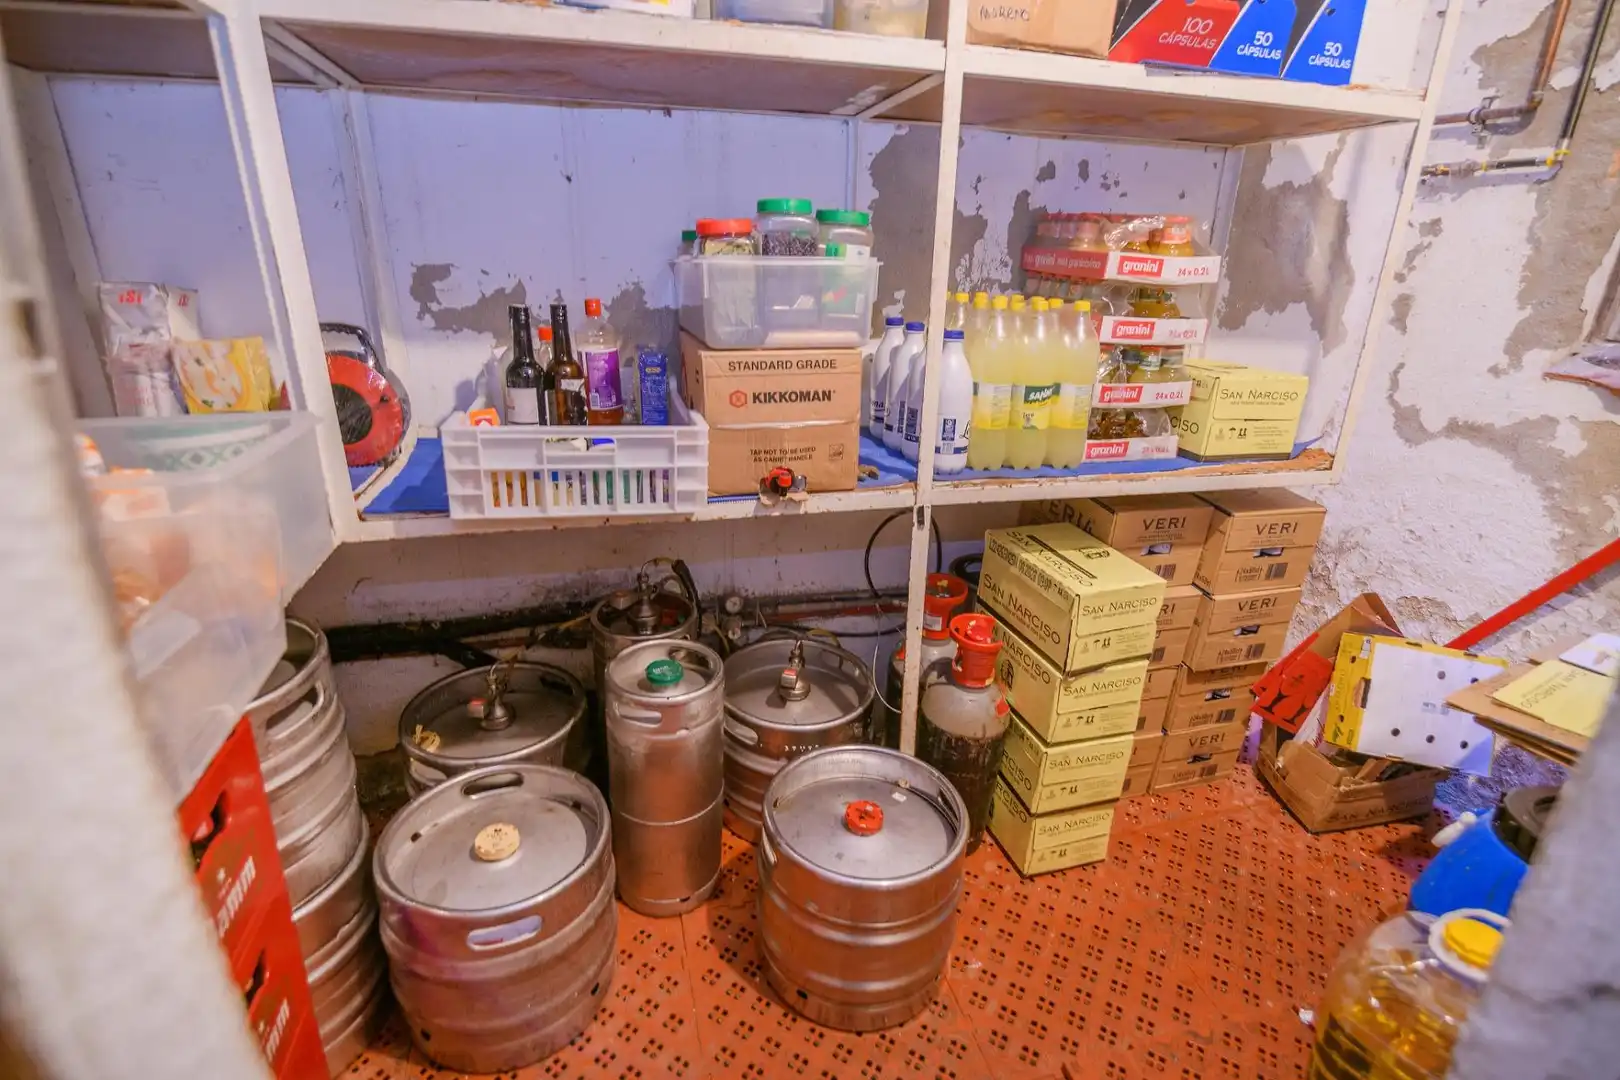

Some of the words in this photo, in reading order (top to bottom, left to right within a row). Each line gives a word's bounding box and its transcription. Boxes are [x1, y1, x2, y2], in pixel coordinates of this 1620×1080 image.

[1183, 17, 1214, 35] 100
[1158, 32, 1217, 49] CÁPSULAS
[1254, 31, 1274, 46] 50
[1237, 44, 1282, 60] CÁPSULAS
[1324, 42, 1343, 56] 50
[1308, 54, 1351, 69] CÁPSULAS
[1122, 260, 1159, 274] granini
[1116, 323, 1151, 337] granini
[728, 359, 793, 372] STANDARD
[796, 358, 837, 370] GRADE
[752, 390, 832, 404] KIKKOMAN
[1155, 392, 1164, 400] 24
[1220, 388, 1243, 400] SAN
[1247, 389, 1299, 402] NARCISO
[1170, 416, 1200, 435] CISO
[750, 448, 763, 456] TAP
[763, 448, 777, 456] NOT
[779, 448, 788, 456] TO
[1090, 443, 1125, 456] granini
[1143, 516, 1187, 531] VERI
[1256, 522, 1299, 536] VERI
[984, 573, 1005, 600] SAN
[1008, 593, 1061, 645] NARCISO
[1081, 604, 1104, 616] SAN
[1108, 596, 1157, 612] NARCISO
[1160, 603, 1176, 614] RI
[1238, 597, 1279, 612] VERI
[1002, 631, 1051, 684] NARCISO
[1063, 685, 1087, 698] SAN
[1092, 676, 1142, 692] NARCISO
[1188, 733, 1226, 748] VERI
[1049, 759, 1071, 771] SAN
[1075, 750, 1124, 766] NARCISO
[1002, 749, 1032, 790] RCISO
[996, 781, 1027, 823] RCISO
[1038, 824, 1060, 836] SAN
[1063, 811, 1110, 828] NARCISO
